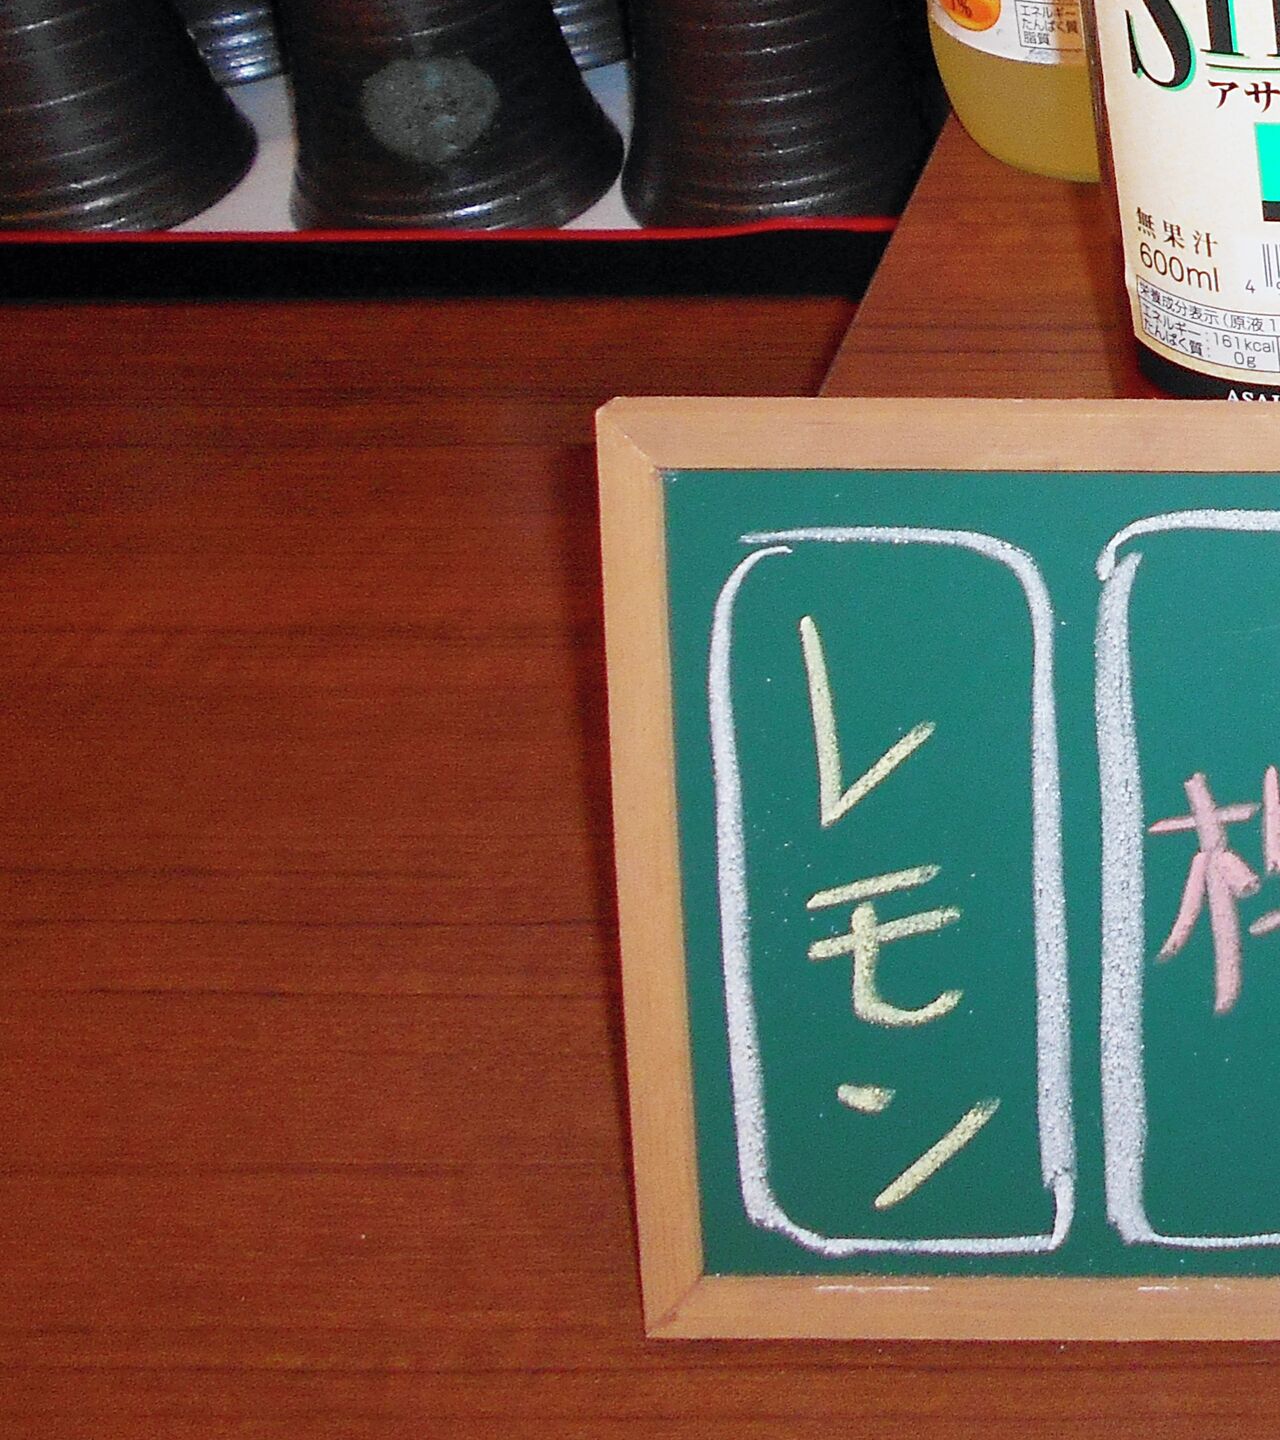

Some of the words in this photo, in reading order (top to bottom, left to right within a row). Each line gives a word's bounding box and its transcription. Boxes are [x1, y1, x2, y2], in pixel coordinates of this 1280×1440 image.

[1136, 206, 1218, 258] 無果汁
[1140, 242, 1220, 293] 600ml
[797, 614, 1000, 1211] レモン
